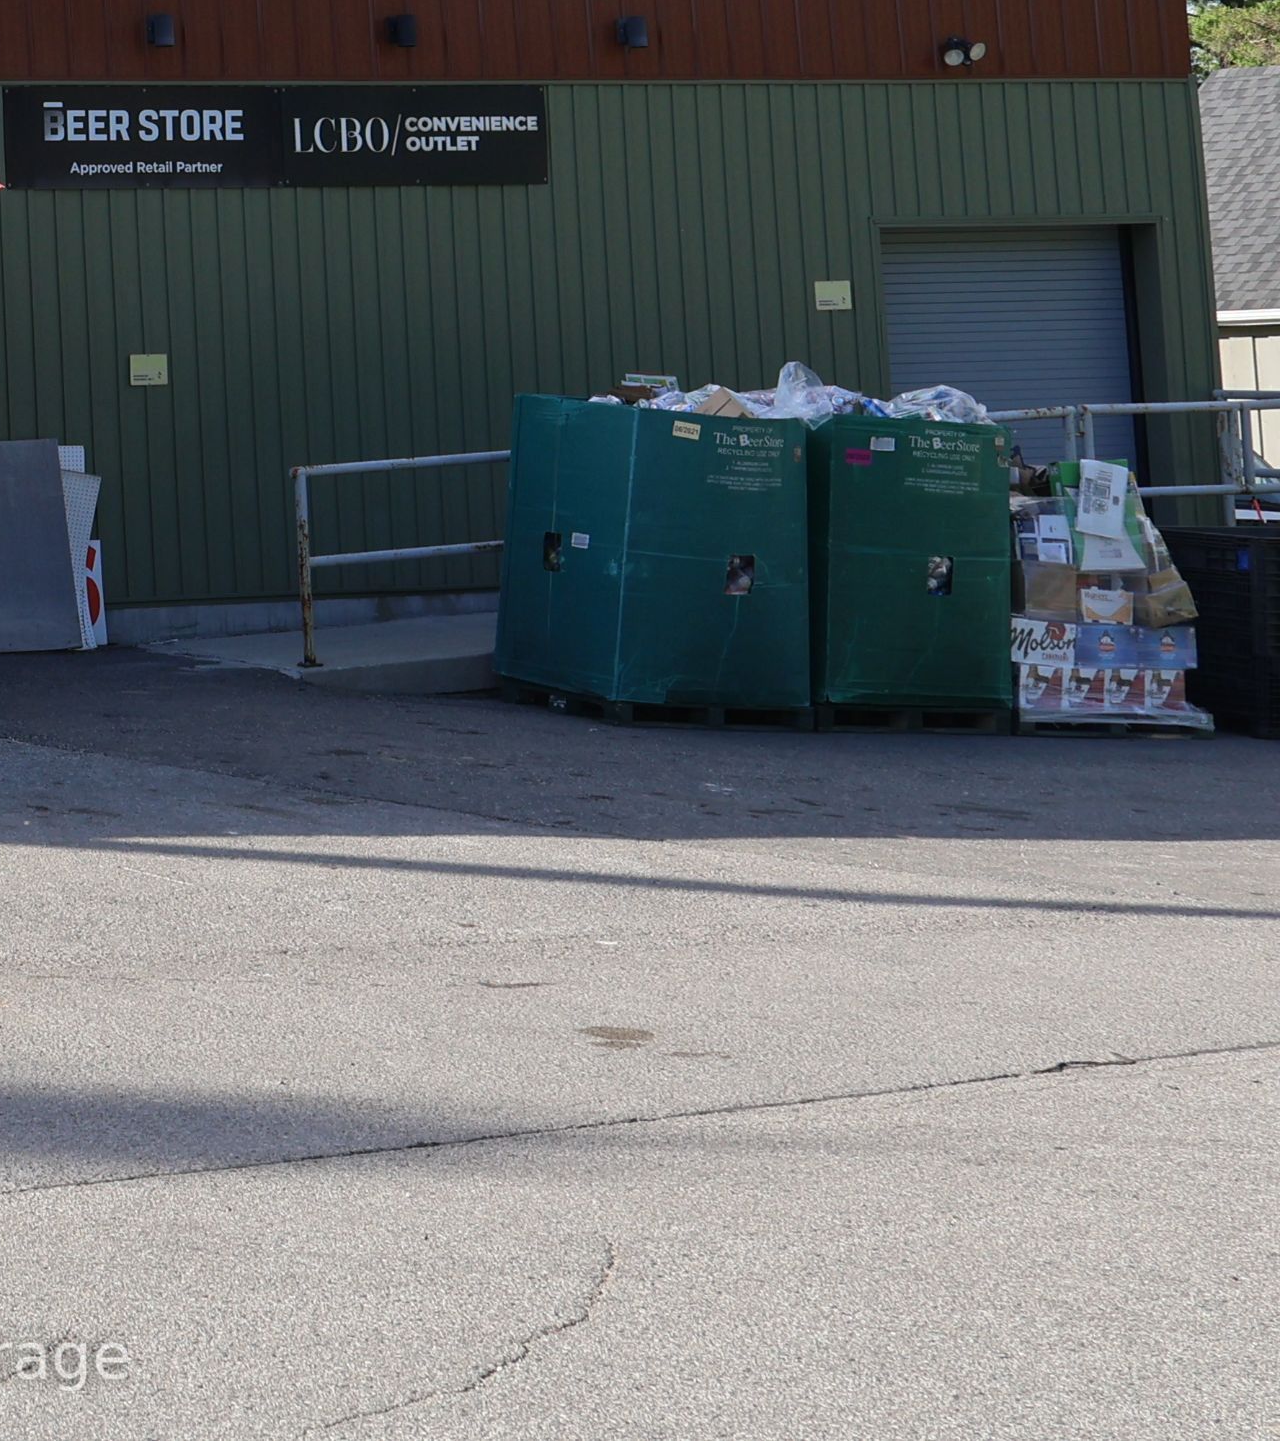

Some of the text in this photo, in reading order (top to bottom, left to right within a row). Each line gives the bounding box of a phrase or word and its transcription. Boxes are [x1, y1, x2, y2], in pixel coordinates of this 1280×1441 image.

[43, 109, 244, 141] BEER STORE
[405, 116, 538, 132] CONVENIENCE
[405, 136, 479, 151] OUTLET
[70, 161, 223, 176] Approved Retail Partner
[713, 431, 737, 445] The
[908, 435, 930, 448] The
[1010, 627, 1077, 659] Molson
